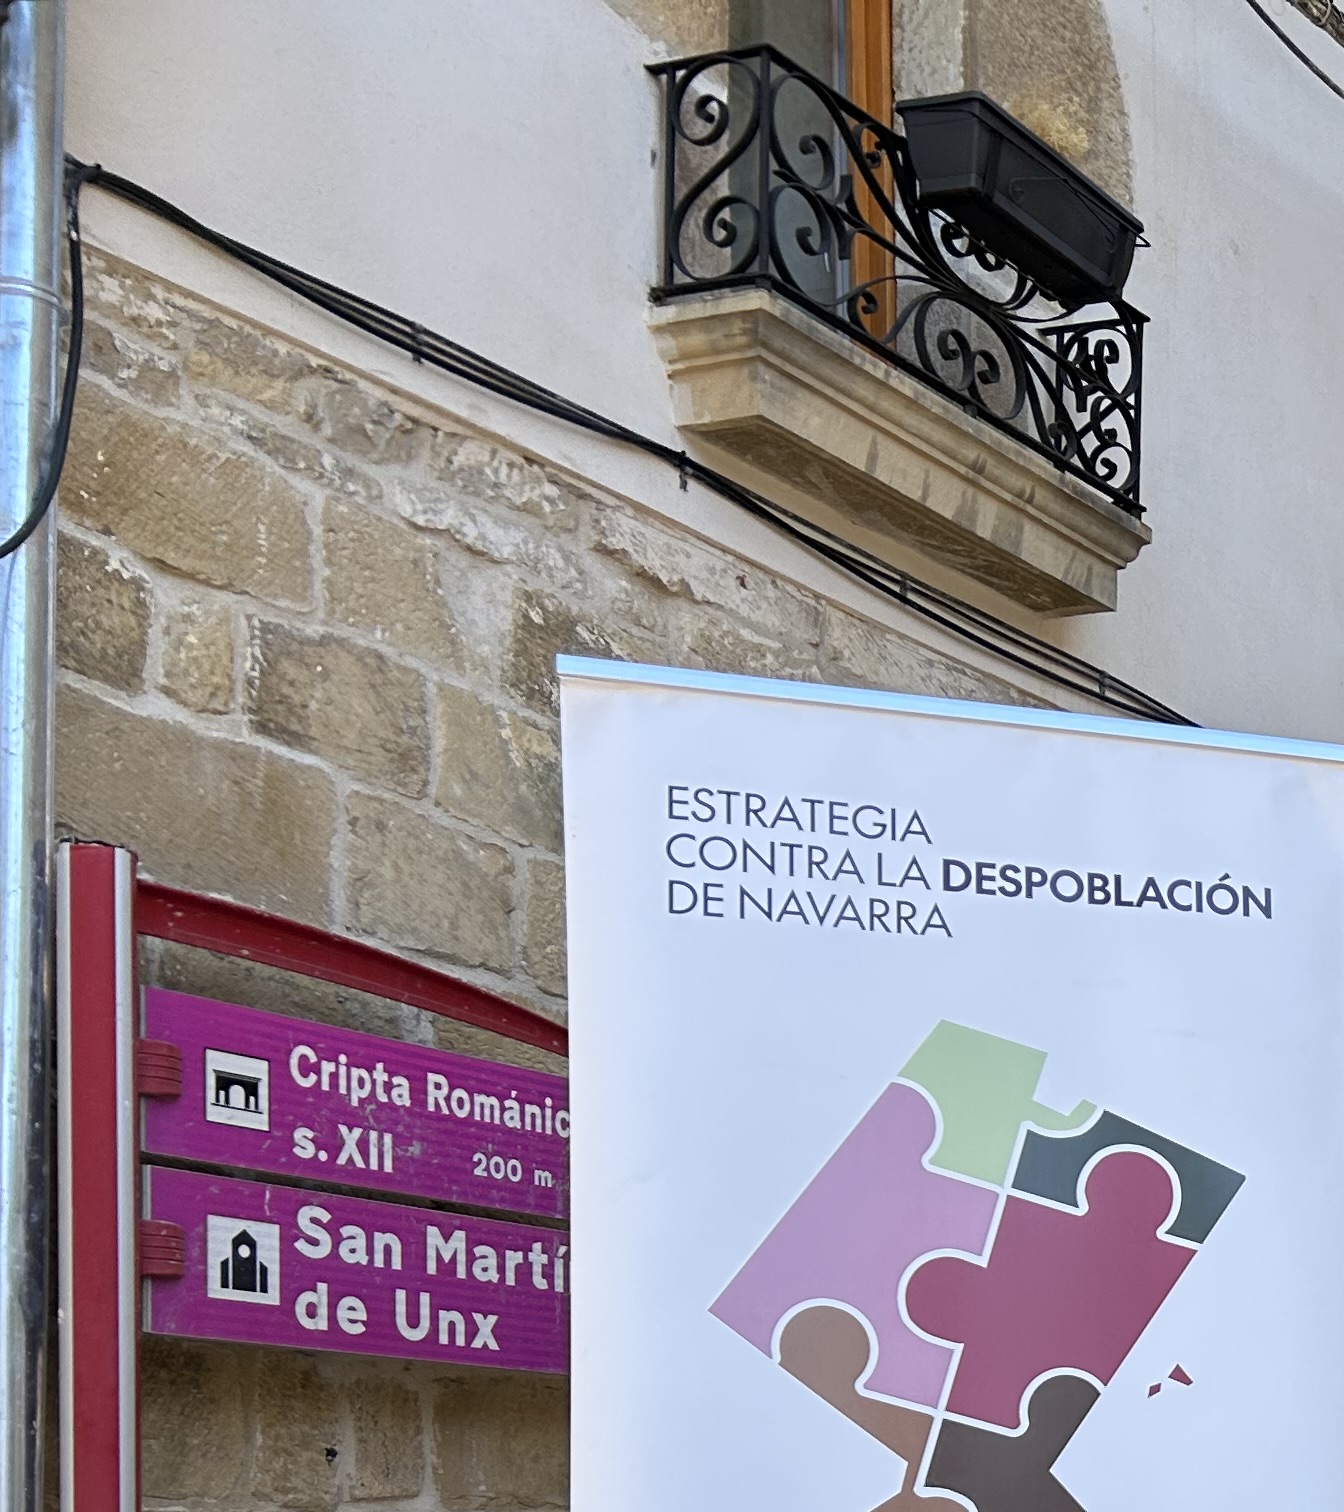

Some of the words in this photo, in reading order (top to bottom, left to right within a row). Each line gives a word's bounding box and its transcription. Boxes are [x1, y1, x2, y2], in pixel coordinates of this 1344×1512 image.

[668, 784, 932, 845] ESTRATEGIA
[666, 833, 865, 886] CONTRA
[877, 851, 931, 890] LA
[942, 857, 1273, 920] DESPOBLACIÓN
[668, 879, 724, 919] DE
[739, 884, 953, 938] NAVARRA
[289, 1044, 412, 1107] Cripta
[427, 1072, 571, 1139] Románic
[472, 1152, 523, 1183] 200
[533, 1167, 553, 1188] m
[293, 1204, 403, 1271] San
[426, 1225, 568, 1294] Martí
[295, 1282, 368, 1335] de
[395, 1288, 501, 1350] Unx
